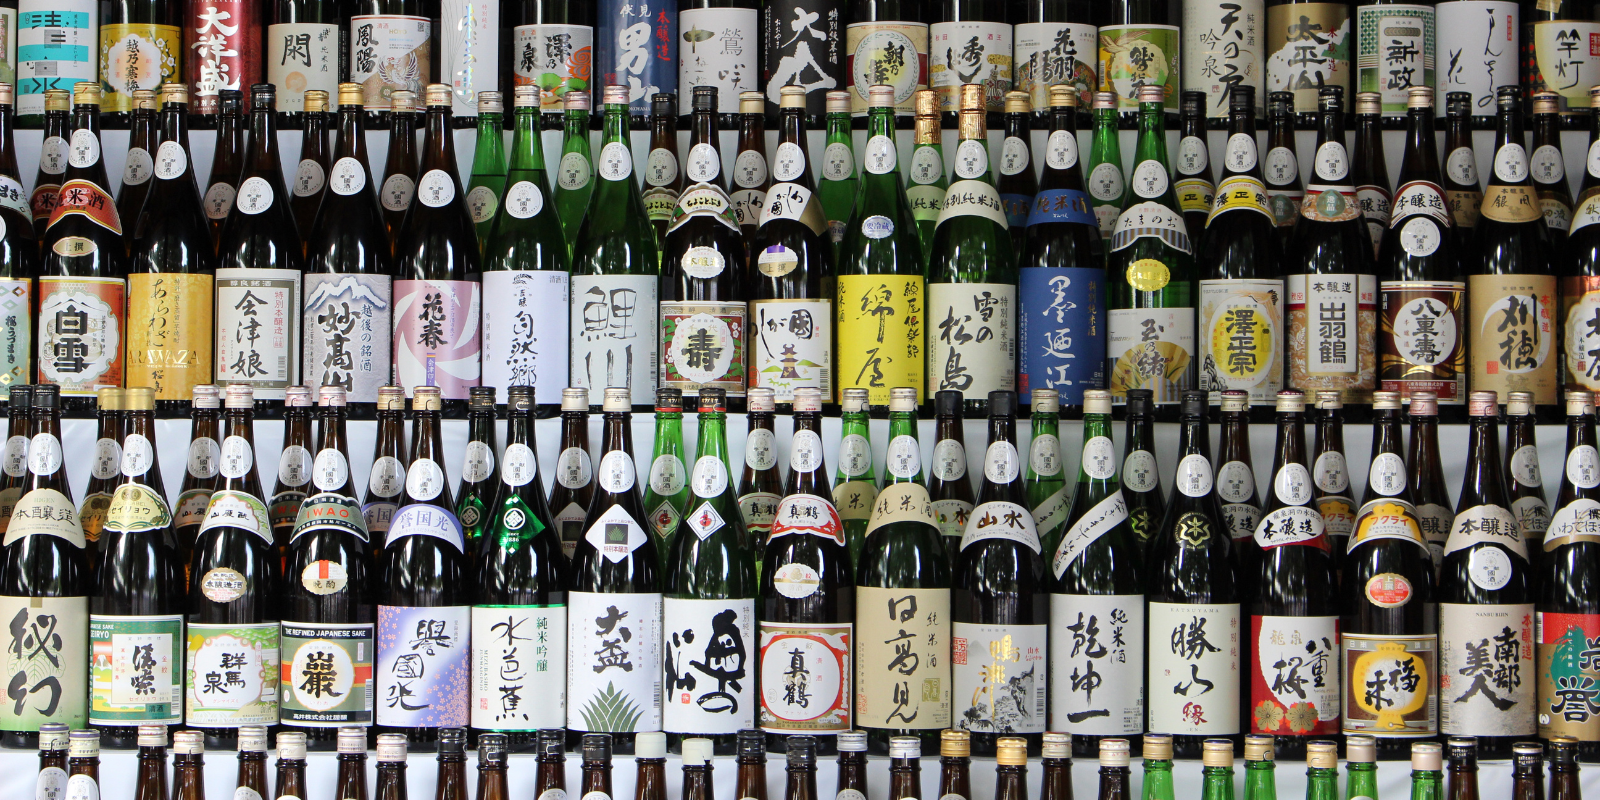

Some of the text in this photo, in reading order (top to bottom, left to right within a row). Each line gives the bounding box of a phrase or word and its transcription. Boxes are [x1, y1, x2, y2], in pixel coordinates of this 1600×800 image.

[620, 4, 651, 18] 伏見
[656, 8, 670, 61] 本醸造
[828, 8, 839, 64] 特別純米酒
[1246, 14, 1255, 46] 純米酒
[125, 39, 139, 92] 越乃寒梅
[191, 7, 241, 97] 大洋盛
[320, 45, 329, 73] 純米酒
[356, 23, 379, 73] 鳳陽
[520, 43, 543, 73] 泉
[615, 22, 660, 103] 男山
[766, 7, 837, 105] 大山
[1200, 29, 1221, 78] 吟泉
[1217, 3, 1245, 108] 天の戸
[1287, 15, 1330, 90] 太平山
[1386, 40, 1420, 90] 新政
[1555, 29, 1584, 90] 竿灯
[686, 198, 722, 207] ちよことぶき
[866, 222, 890, 230] 要冷蔵
[942, 192, 1000, 212] 特別純米酒
[1035, 194, 1087, 214] 純米酒
[1124, 214, 1178, 228] たまのお
[1397, 193, 1443, 211] 本醸造
[767, 263, 787, 273] 上撰
[1313, 282, 1352, 293] 本醸造
[149, 278, 170, 347] あらわざ
[274, 291, 284, 335] 特別本醸造
[418, 292, 448, 350] 花春
[974, 291, 999, 344] 雪の
[999, 295, 1008, 352] 特別純米酒
[1087, 280, 1097, 336] 特別純米酒
[1319, 302, 1346, 364] 出羽鶴
[1410, 299, 1441, 363] 八重寿
[1498, 293, 1538, 370] 刈穂
[1541, 294, 1550, 333] 本醸造
[53, 304, 96, 374] 白雪
[129, 350, 200, 365] ARAWAZA
[230, 290, 268, 378] 会津娘
[318, 302, 361, 392] 妙高山
[360, 304, 373, 372] 越後の銘酒
[580, 286, 637, 390] 鯉川
[681, 328, 723, 372] 寿
[856, 284, 895, 388] 綿屋
[938, 305, 973, 391] 松島
[1225, 309, 1258, 376] 澤正宗
[14, 505, 75, 527] 本醸造
[111, 506, 151, 516] セイリョウ
[306, 508, 349, 519] IWAO
[400, 510, 449, 532] 誉国光
[788, 504, 819, 519] 真鶴
[877, 494, 933, 520] 純米酒
[976, 510, 1026, 531] 山水
[1263, 516, 1317, 540] 本醸造
[1371, 515, 1409, 526] フクライ
[1459, 517, 1519, 542] 本醸造
[312, 580, 336, 589] 晩酌
[292, 629, 315, 637] REFINED
[536, 617, 548, 672] 純米吟醸
[593, 605, 633, 673] 大盃
[926, 612, 940, 669] 純米酒
[1110, 608, 1128, 664] 純米酒
[1171, 616, 1221, 698] 勝山
[1521, 613, 1532, 660] 本醸造
[8, 607, 62, 717] 秘幻
[161, 655, 168, 674] 金紋
[203, 671, 229, 694] 泉
[220, 653, 248, 688] 群馬
[490, 615, 533, 722] 水芭蕉
[783, 647, 812, 708] 真鶴
[816, 657, 823, 682] 清酒
[884, 595, 920, 724] 日高見
[1067, 612, 1110, 723] 乾坤一
[1302, 637, 1332, 688] 八重
[1388, 657, 1421, 693] 福
[1454, 638, 1518, 711] 美人
[1492, 626, 1521, 693] 南部
[148, 705, 163, 713] 清酒
[1182, 702, 1208, 726] 縁
[1551, 676, 1600, 723] 誉
